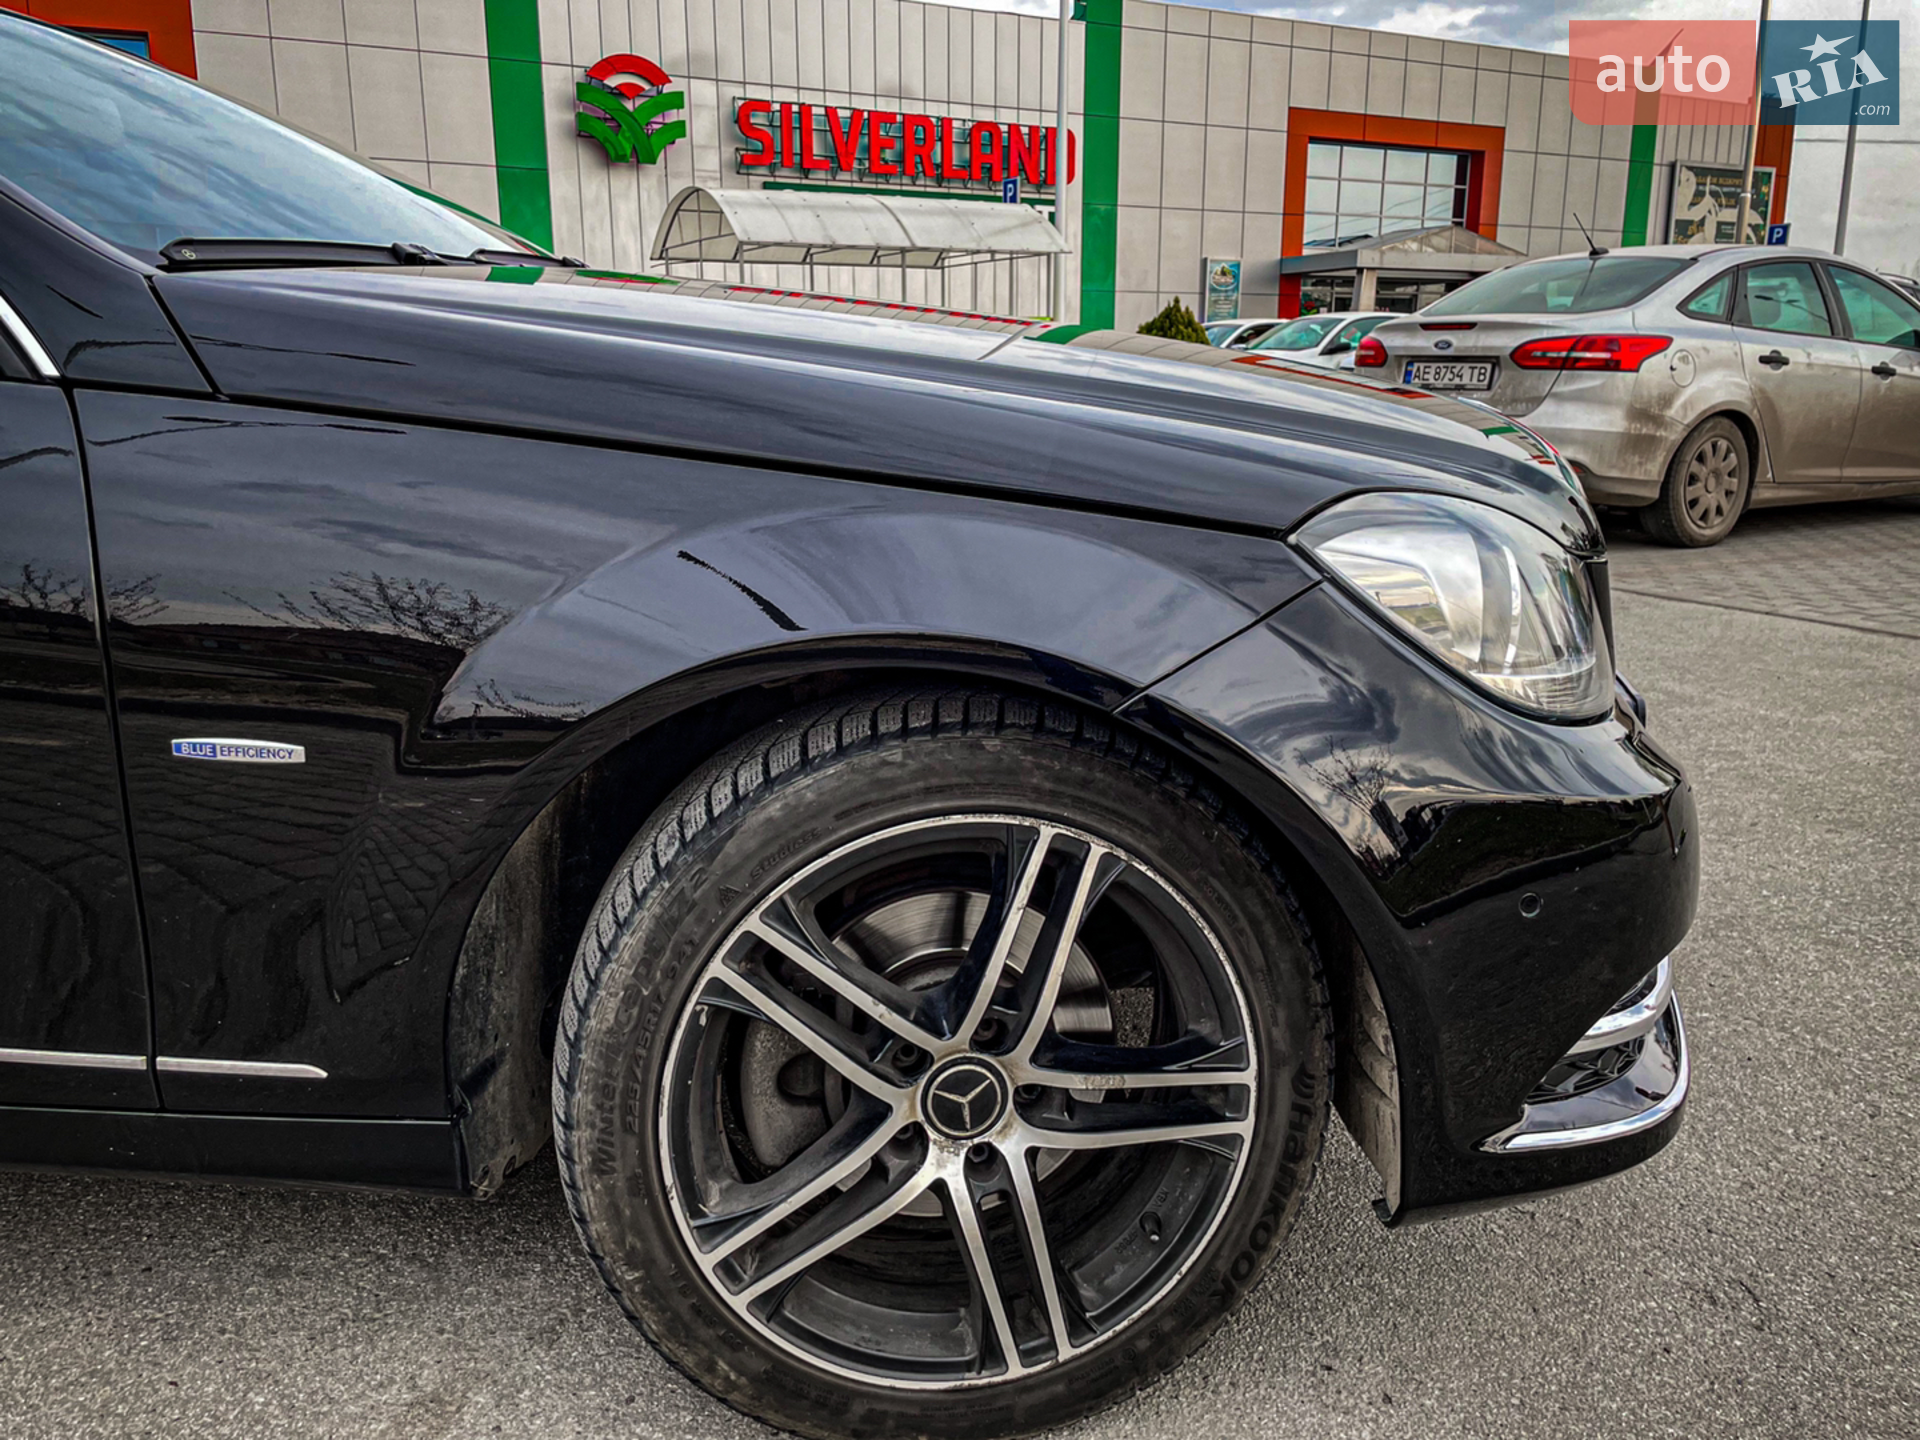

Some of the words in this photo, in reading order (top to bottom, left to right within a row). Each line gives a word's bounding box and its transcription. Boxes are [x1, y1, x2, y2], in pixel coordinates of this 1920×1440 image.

[737, 100, 1076, 186] SILVERLAND
[1006, 184, 1016, 201] P
[1772, 228, 1783, 243] P
[1413, 365, 1432, 382] AE
[1433, 365, 1465, 382] 8754
[1468, 365, 1488, 383] TB
[181, 743, 214, 756] BLUE
[219, 745, 294, 759] EFFICIENCY
